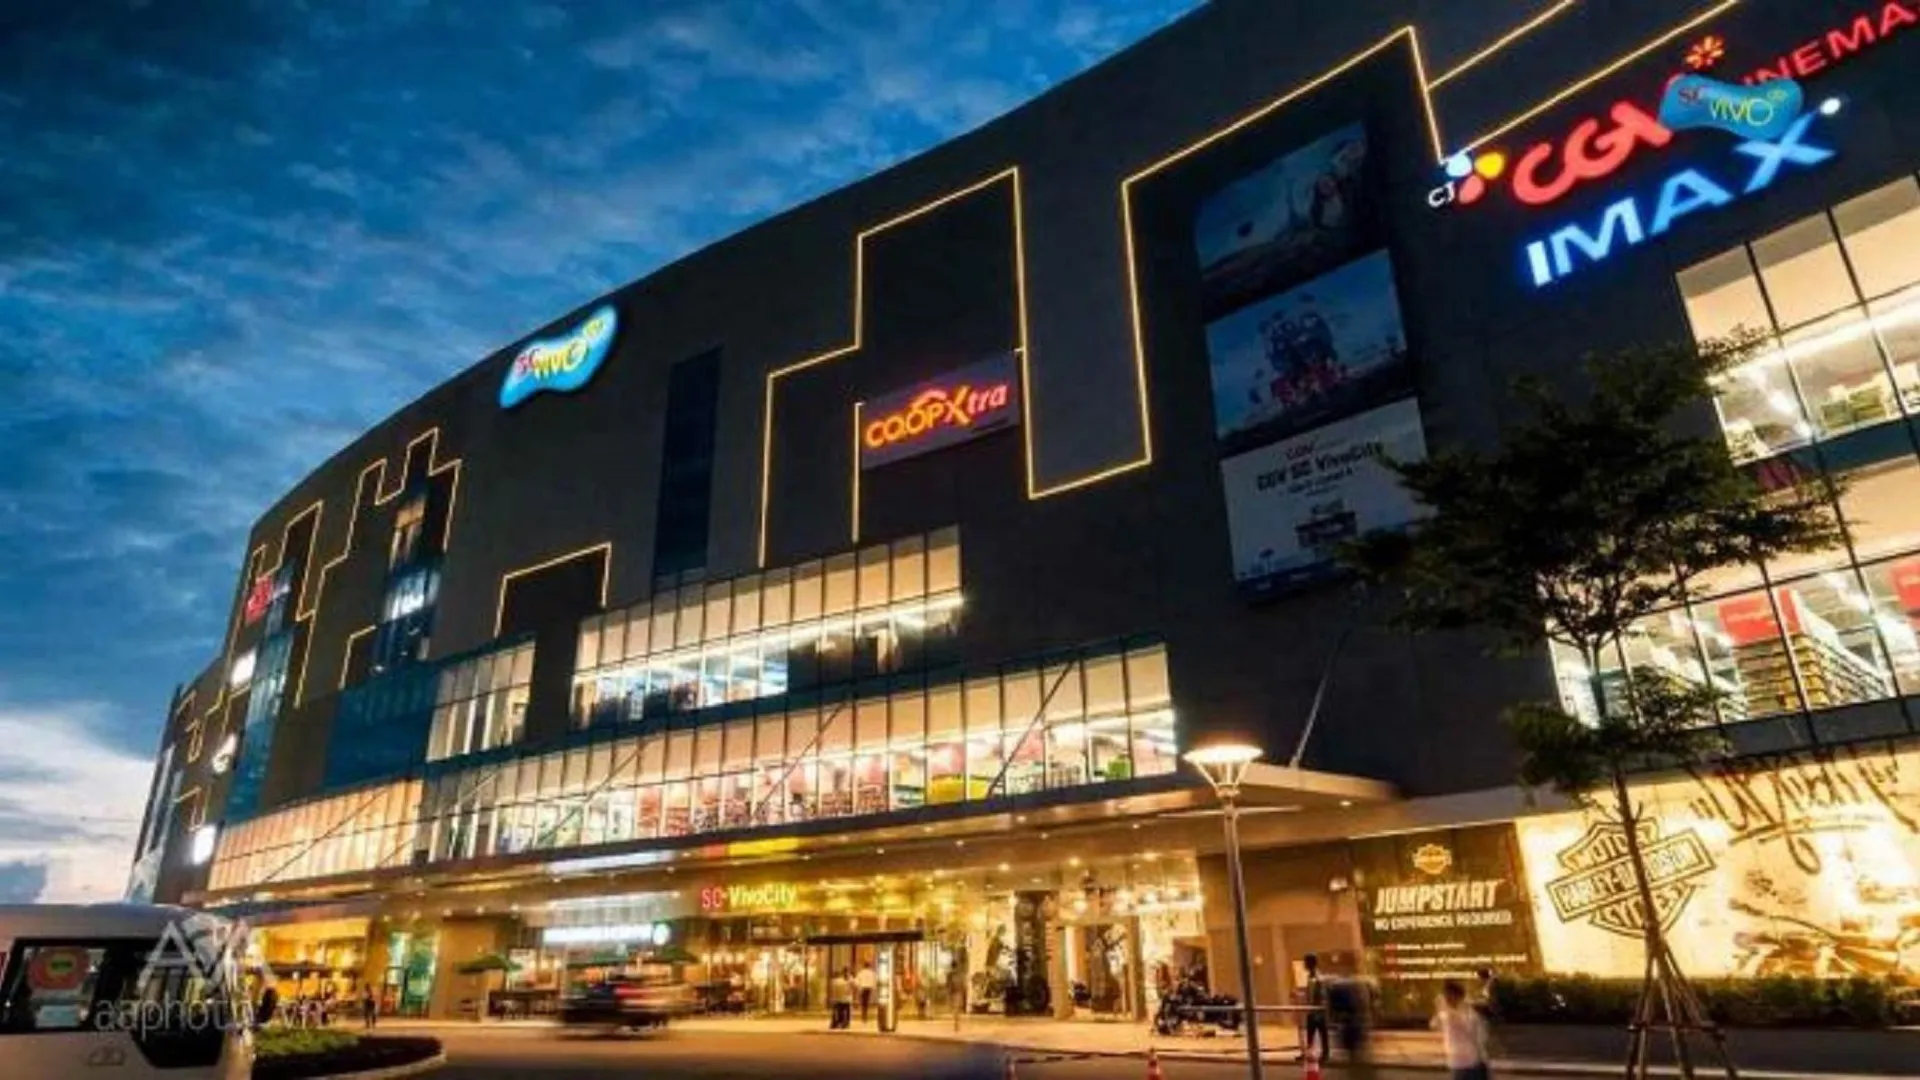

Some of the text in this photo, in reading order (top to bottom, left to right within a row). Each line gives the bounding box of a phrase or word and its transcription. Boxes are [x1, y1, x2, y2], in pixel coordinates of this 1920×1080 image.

[1428, 181, 1455, 208] CJ
[1525, 97, 1842, 288] IMAX
[1374, 879, 1506, 915] JUMPSTART
